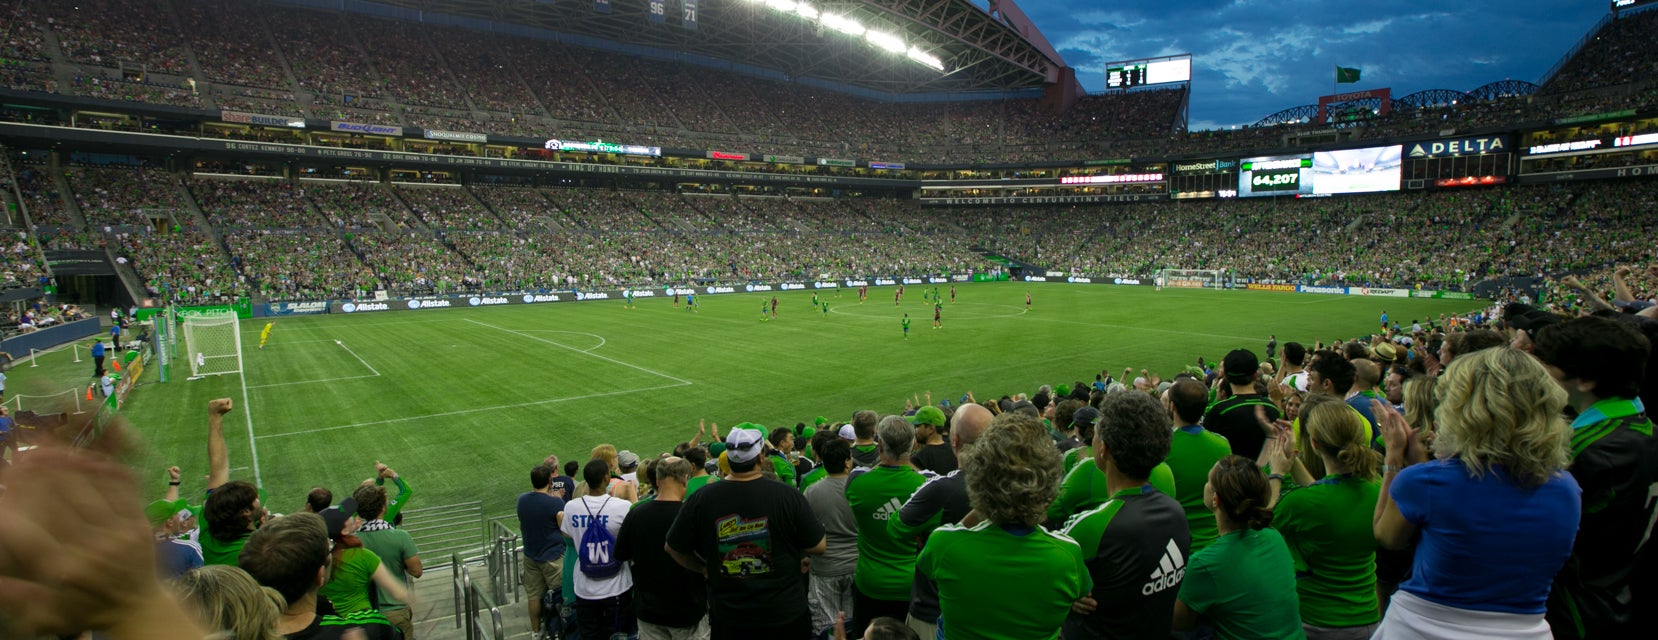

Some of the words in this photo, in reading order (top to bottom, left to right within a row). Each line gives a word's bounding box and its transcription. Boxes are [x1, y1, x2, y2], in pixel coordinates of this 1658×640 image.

[650, 2, 664, 15] 96
[684, 9, 696, 21] 71
[1337, 91, 1372, 101] TOYOTA
[1431, 137, 1503, 154] DELTA
[1176, 161, 1217, 172] HomeStreet
[1252, 173, 1298, 186] 64,207
[1248, 283, 1271, 291] WELLS
[1272, 284, 1296, 292] FARGO
[1300, 285, 1344, 294] Panasonic
[632, 289, 654, 297] Allstate
[480, 297, 508, 305] Allstate
[534, 294, 560, 302] Allstate
[287, 301, 327, 310] SLALOM
[356, 302, 389, 311] Allstate
[420, 300, 451, 308] Allstate
[586, 540, 610, 564] W
[1142, 566, 1186, 596] adidas
